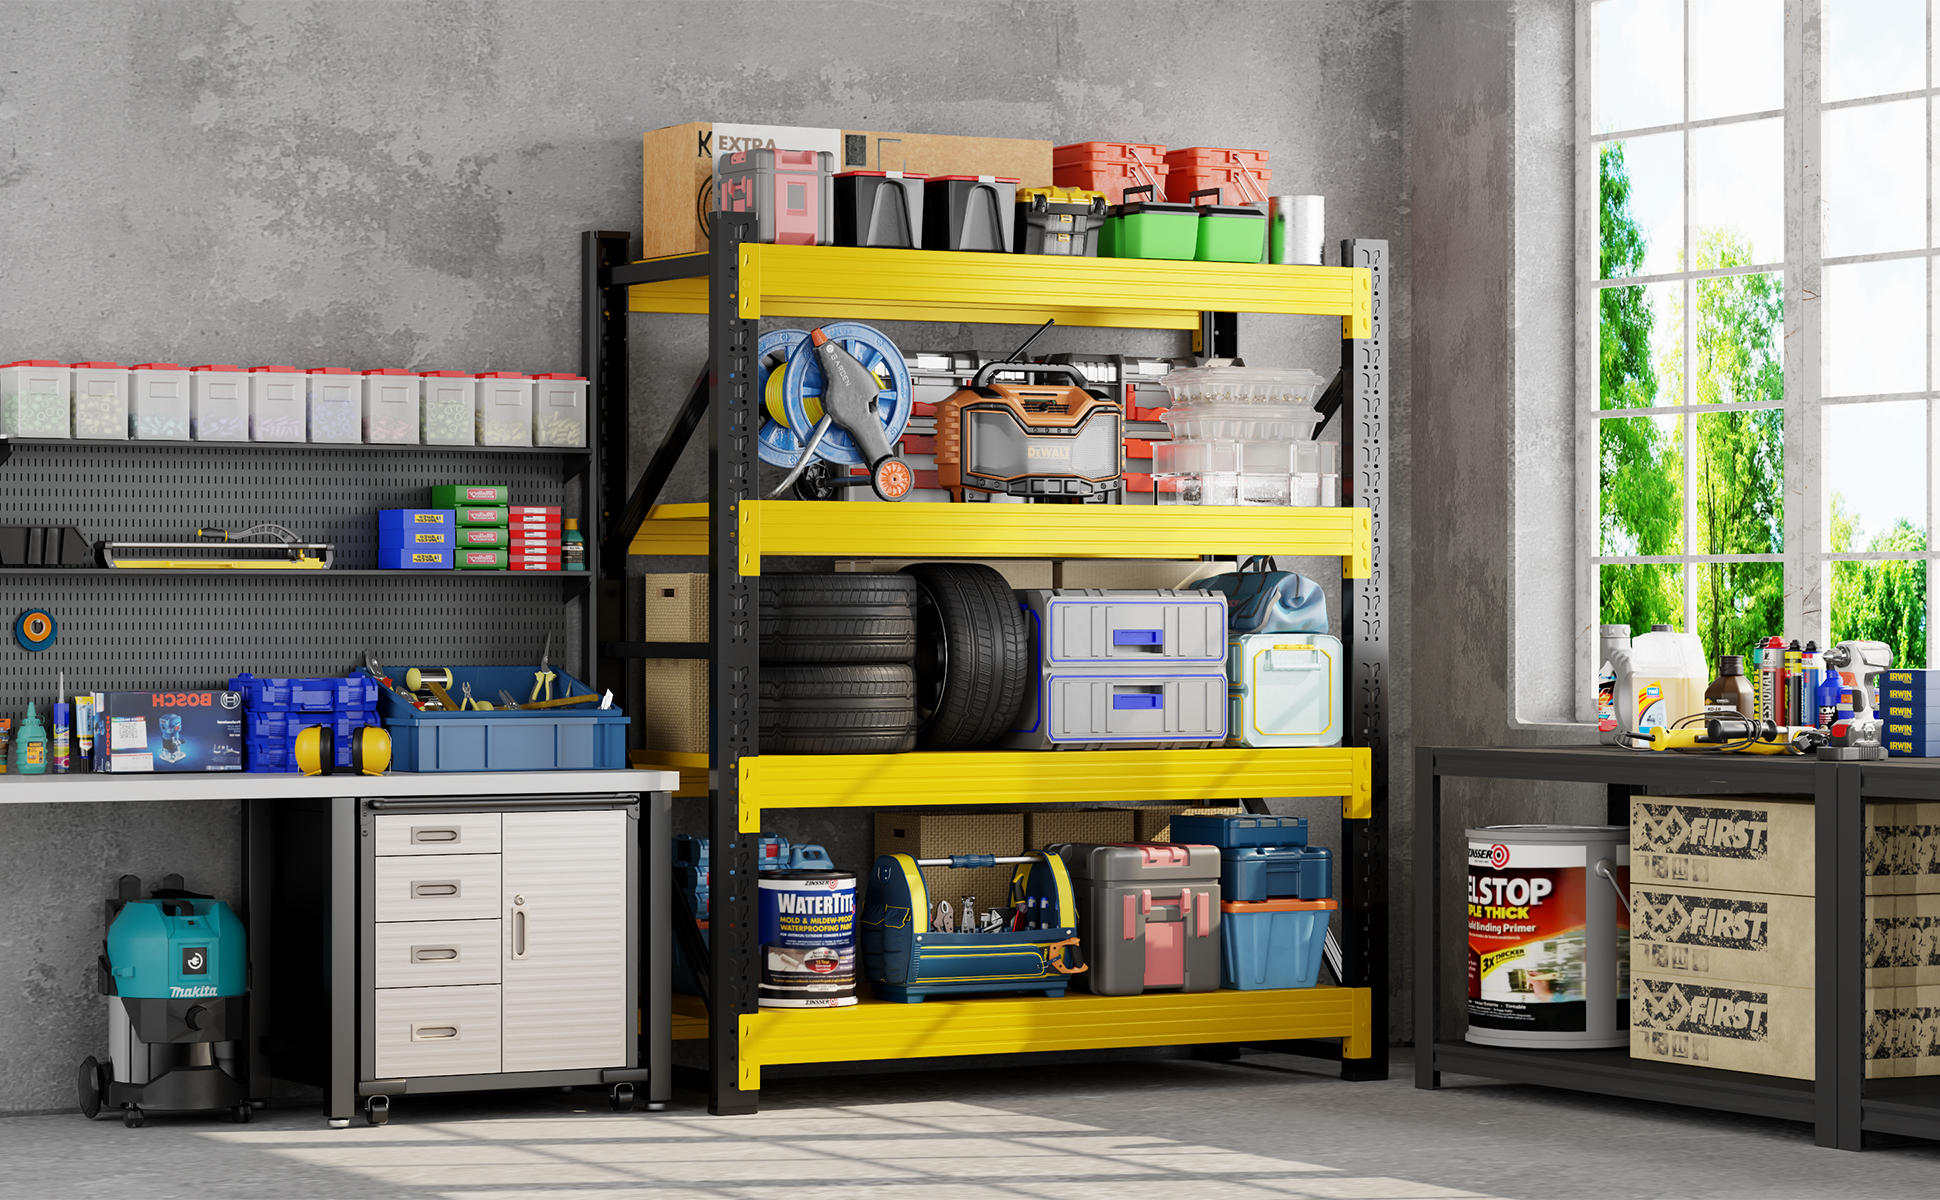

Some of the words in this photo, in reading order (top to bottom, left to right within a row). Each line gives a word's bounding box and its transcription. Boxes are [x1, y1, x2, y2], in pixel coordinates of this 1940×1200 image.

[719, 136, 776, 152] EXTRA
[831, 354, 852, 386] GARDEN
[1890, 673, 1912, 681] IRWIN
[1890, 690, 1912, 698] IRWIN
[1890, 707, 1912, 716] IRWIN
[1890, 725, 1912, 733] IRWIN
[1890, 742, 1912, 750] IRWIN
[1690, 817, 1767, 850] FIRST
[1484, 906, 1529, 919] THICK
[1503, 923, 1536, 932] Primer
[1690, 908, 1767, 941] FIRST
[1495, 949, 1524, 960] THICKER
[1690, 997, 1767, 1030] FIRST
